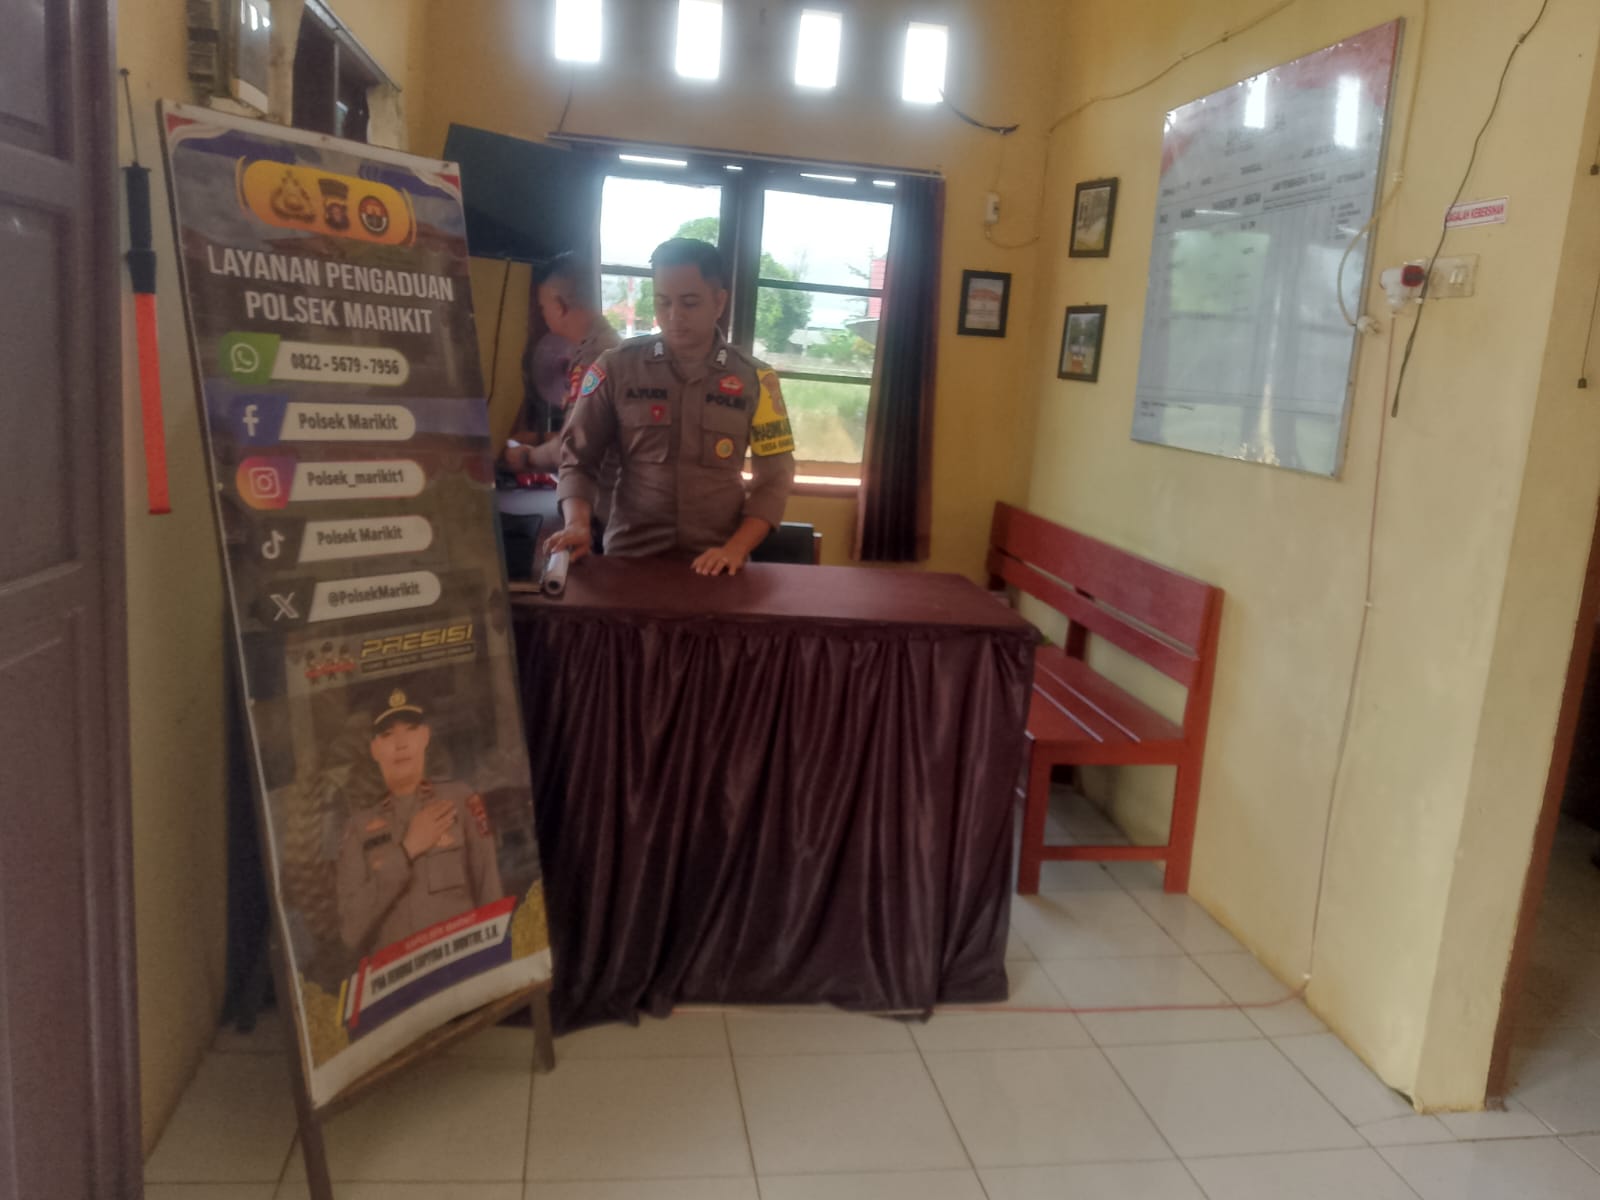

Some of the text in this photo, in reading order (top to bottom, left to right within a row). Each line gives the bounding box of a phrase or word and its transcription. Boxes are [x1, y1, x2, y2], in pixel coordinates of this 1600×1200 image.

[207, 245, 454, 301] LAYANAN PENGADUAN
[244, 290, 432, 334] POLSEK MARIKIT
[298, 411, 398, 430] Polsek Marikit
[316, 525, 403, 545] Polsek Marikit
[327, 581, 421, 608] @PolsekMarikit
[360, 623, 474, 659] PRESISI
